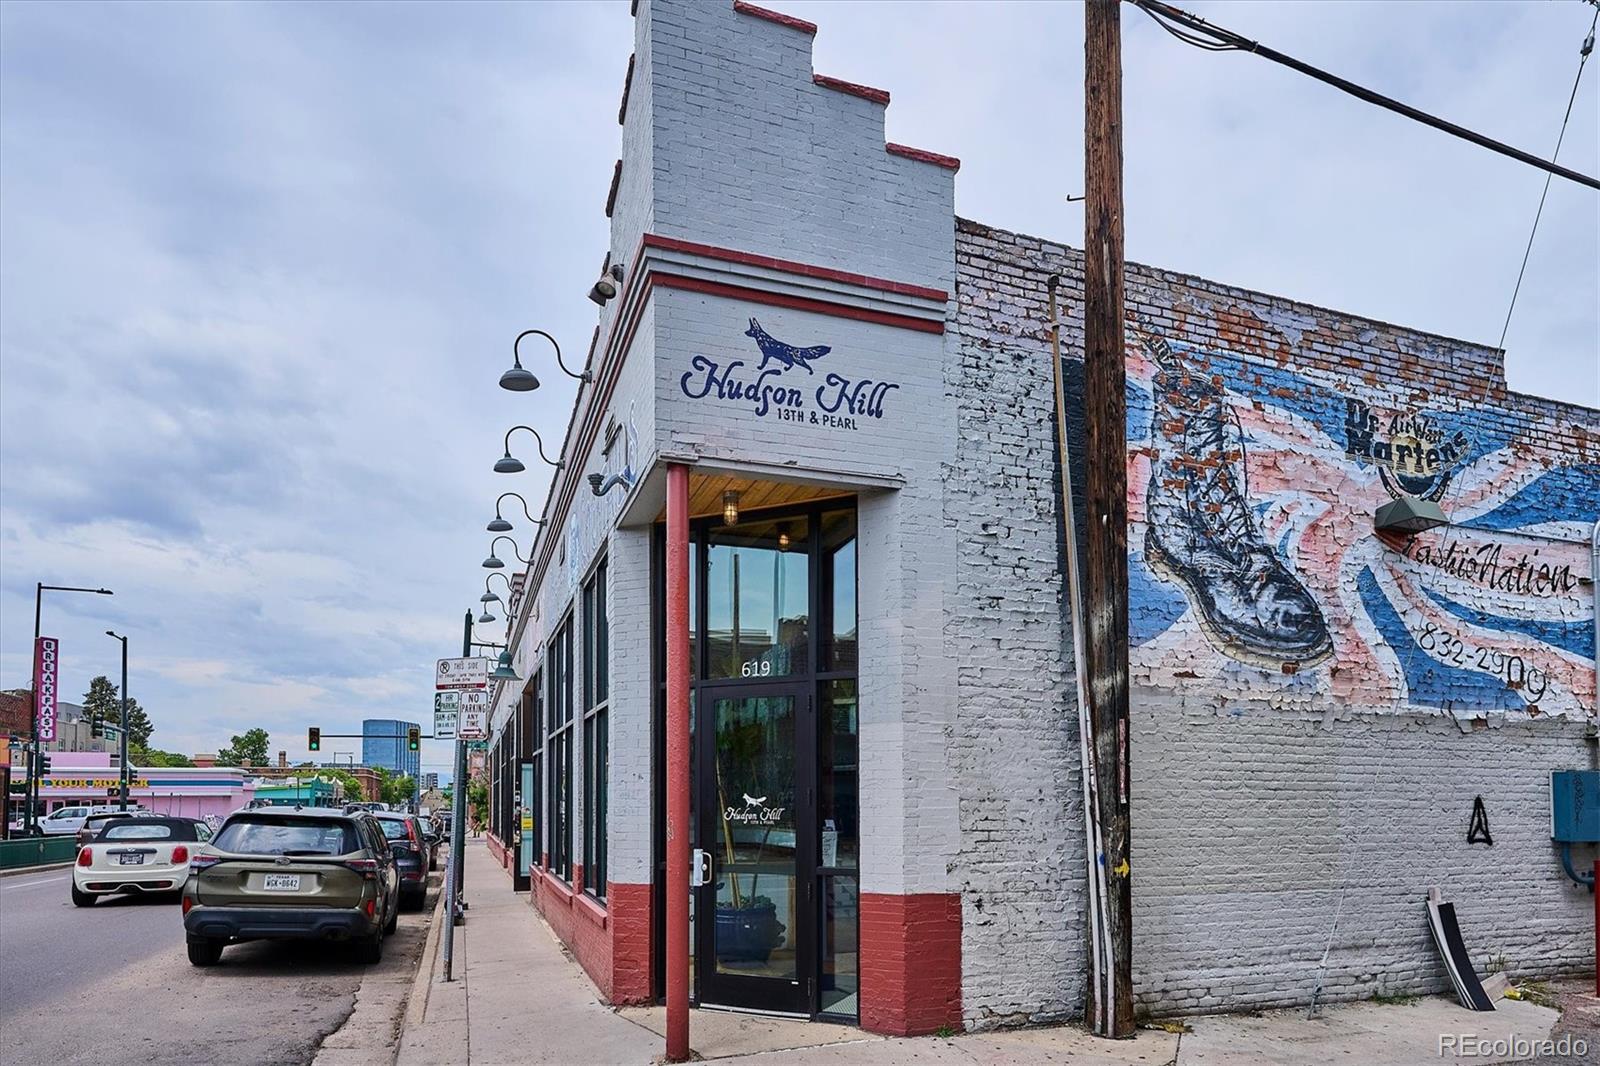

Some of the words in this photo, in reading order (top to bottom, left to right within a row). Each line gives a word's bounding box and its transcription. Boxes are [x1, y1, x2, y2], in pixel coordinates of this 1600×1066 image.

[680, 355, 803, 417] Hudson
[815, 373, 900, 419] Hill
[777, 407, 804, 422] 13TH
[809, 410, 820, 425] &
[822, 414, 858, 430] PEARL
[1345, 428, 1469, 468] Martens
[741, 660, 770, 678] 619
[1419, 621, 1547, 704] 832-2909
[44, 641, 53, 737] BREAKFAST
[468, 693, 479, 703] NO
[435, 695, 442, 709] 2
[462, 703, 486, 713] PARKING
[51, 779, 87, 787] YOUR
[93, 779, 150, 788] MOTER
[723, 806, 757, 824] Hudson
[760, 806, 785, 820] Hill
